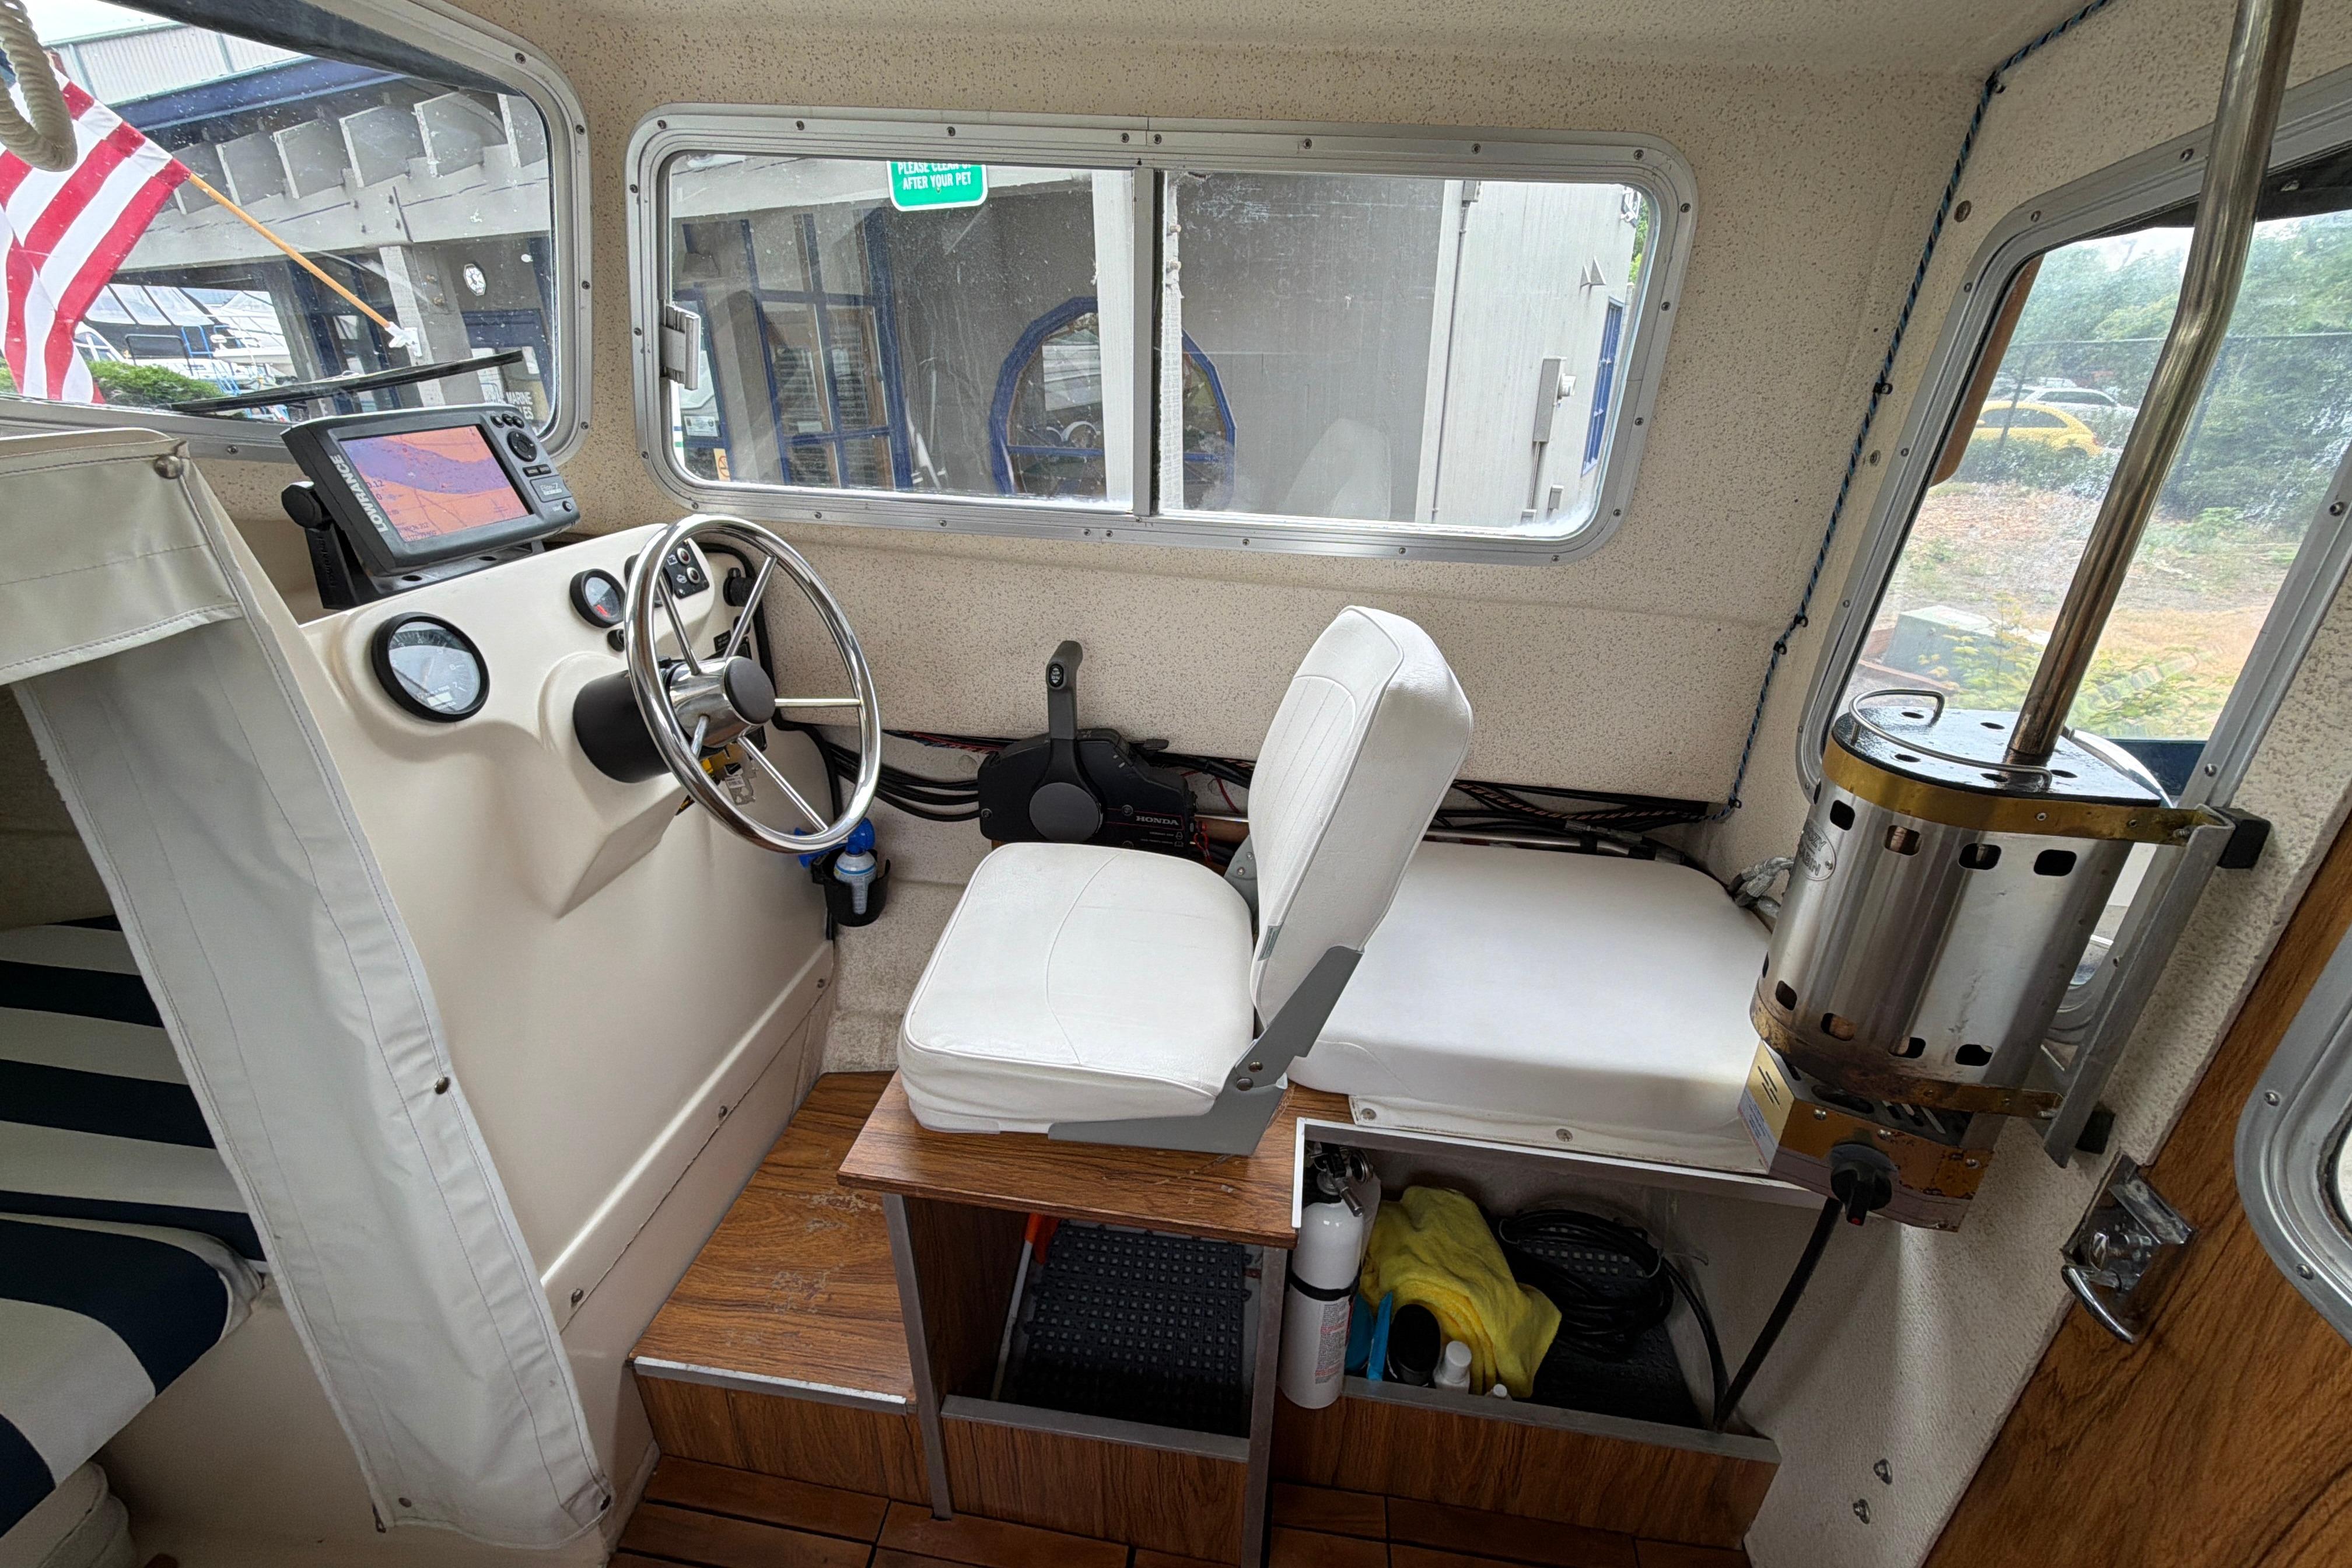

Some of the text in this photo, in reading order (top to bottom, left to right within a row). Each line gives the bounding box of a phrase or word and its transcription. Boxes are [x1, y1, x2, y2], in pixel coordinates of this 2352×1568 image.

[898, 162, 930, 175] PLEASE
[902, 172, 971, 190] AFTER YOUR PET
[505, 391, 533, 405] MARINE
[329, 454, 388, 533] LOWRANCE
[1136, 816, 1180, 826] HONDA
